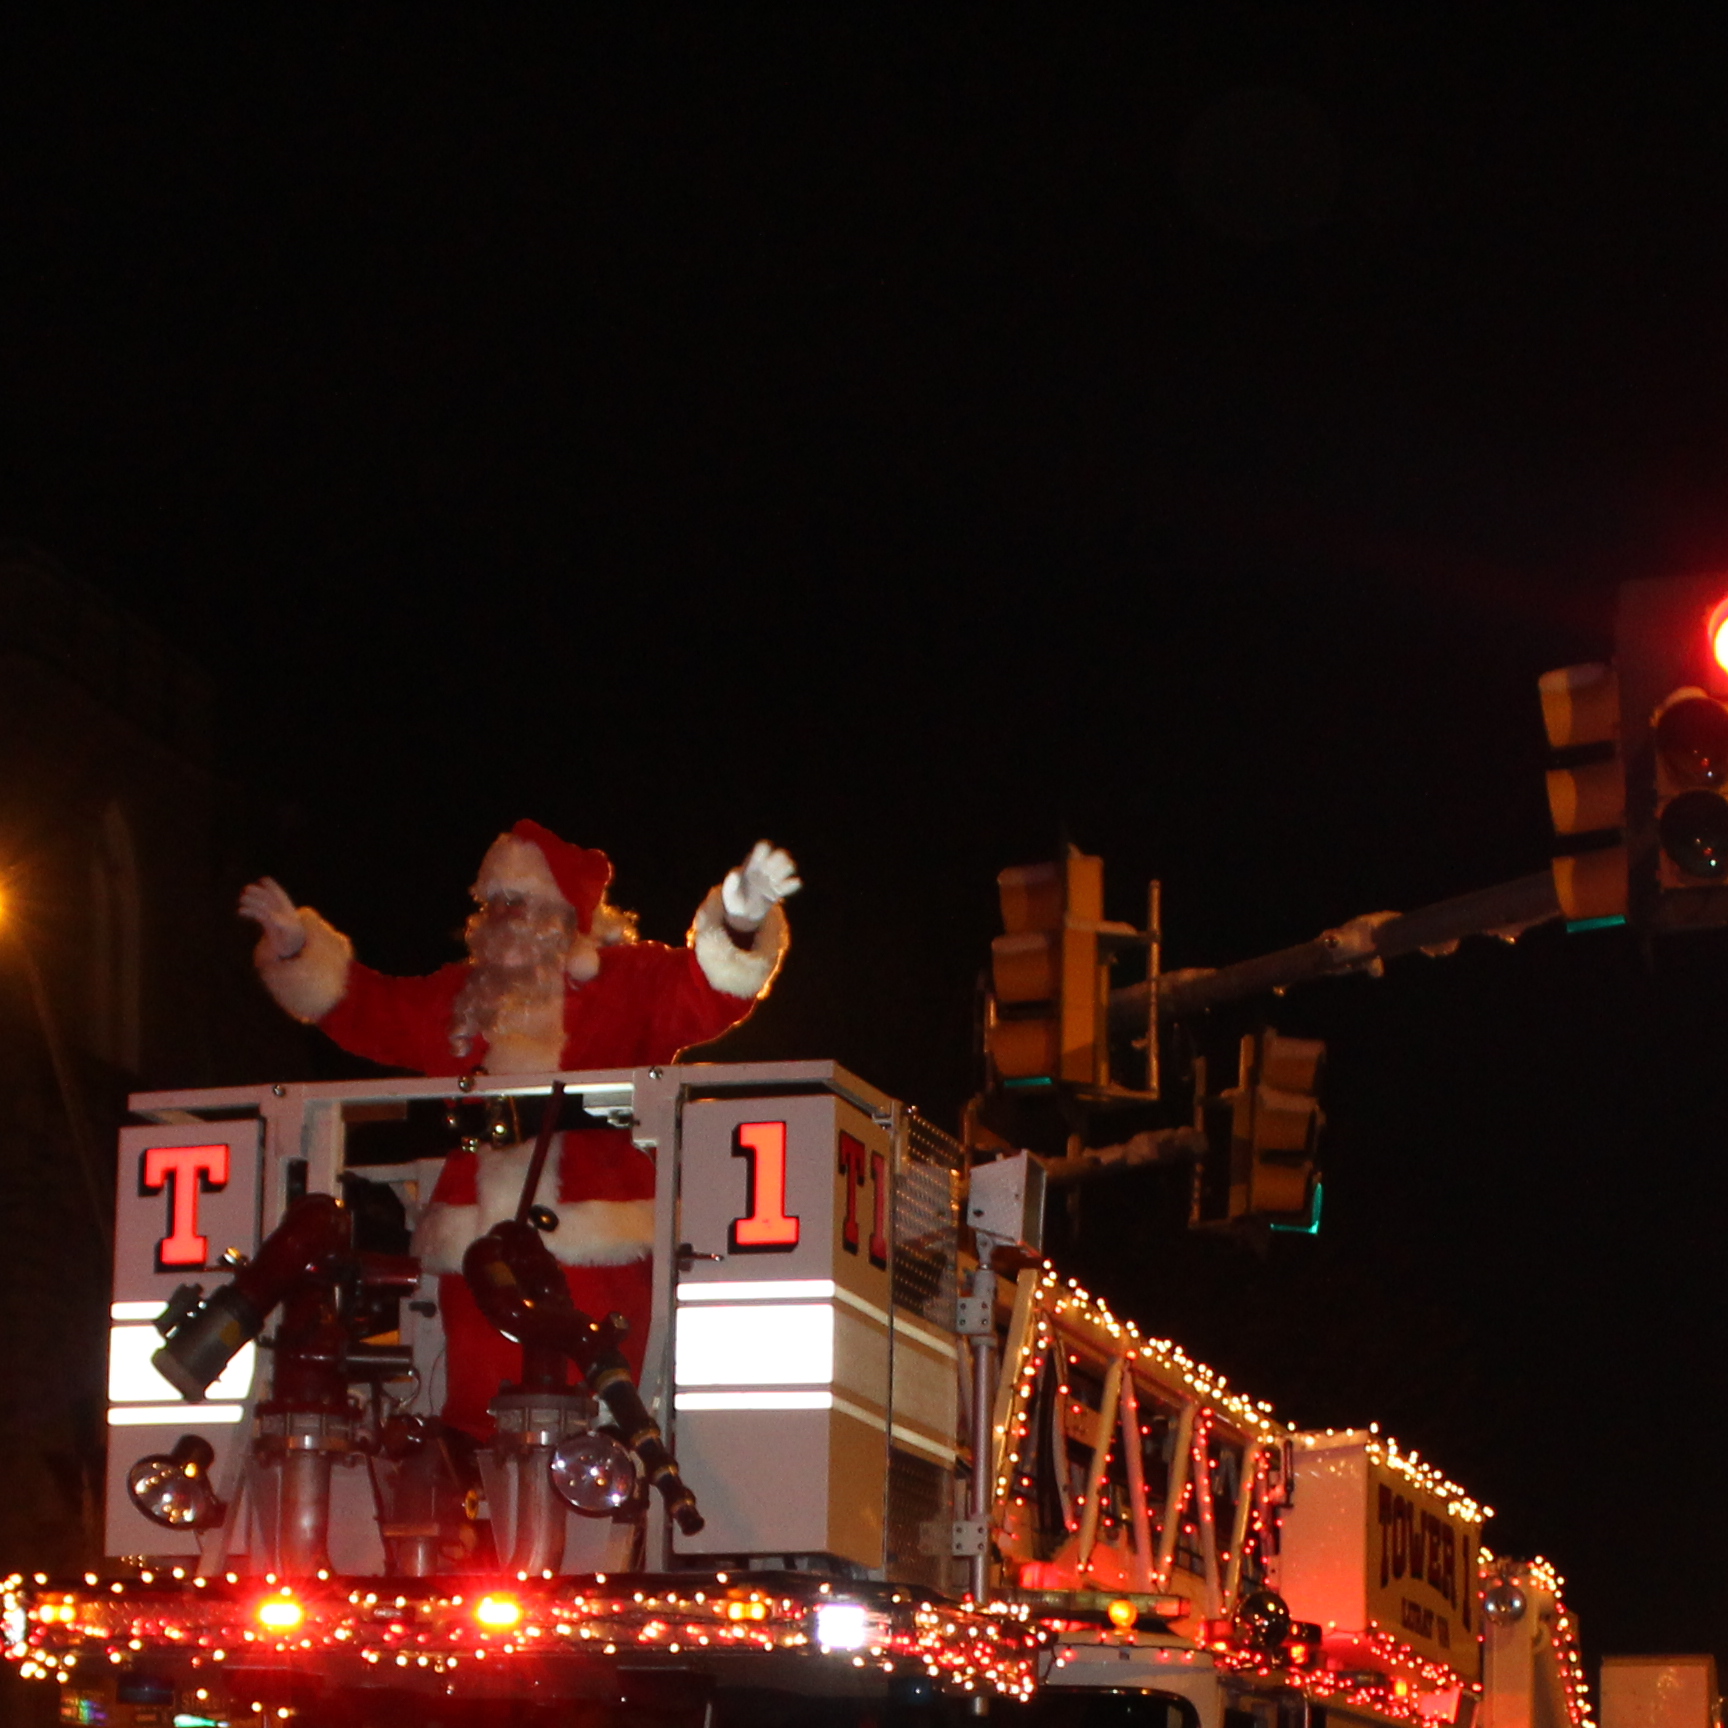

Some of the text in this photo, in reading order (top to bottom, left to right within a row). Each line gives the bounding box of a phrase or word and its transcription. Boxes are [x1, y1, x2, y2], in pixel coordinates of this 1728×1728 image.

[138, 1121, 800, 1274] T 1
[838, 1129, 887, 1272] T1
[1379, 1482, 1456, 1611] TOWER
